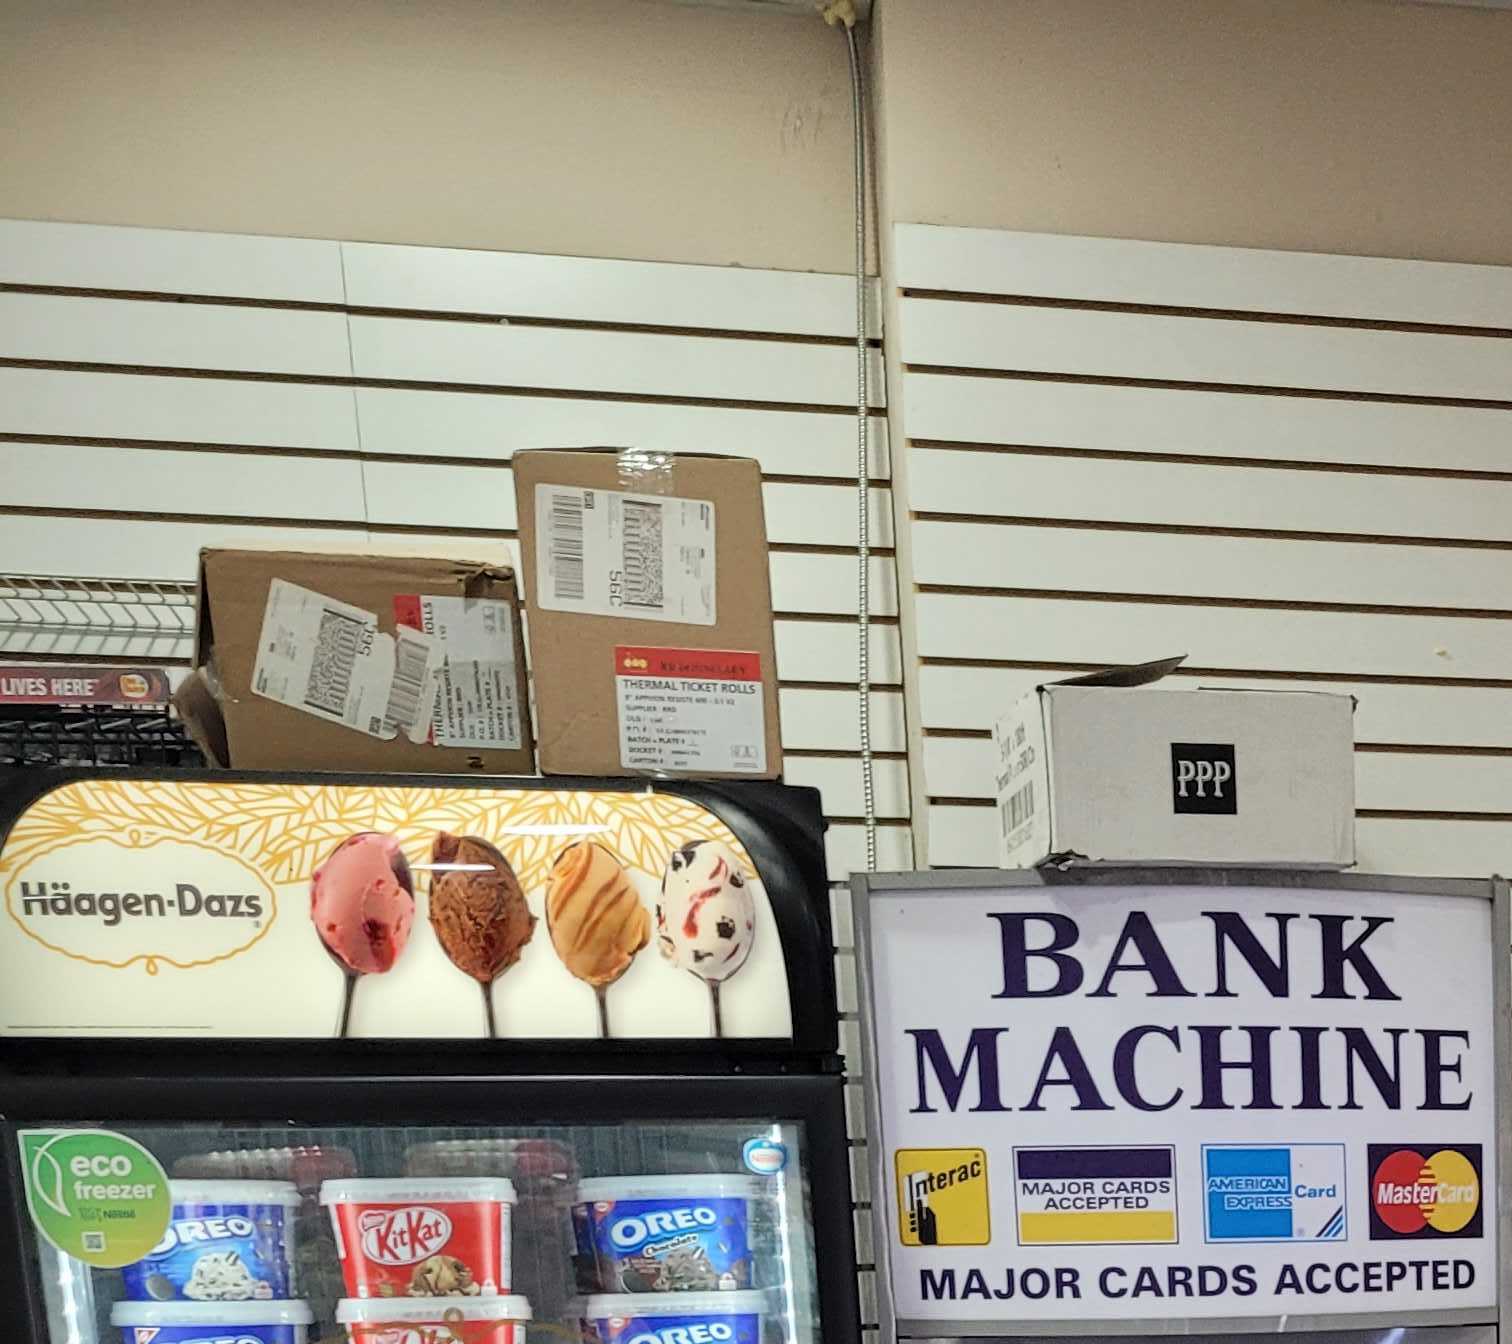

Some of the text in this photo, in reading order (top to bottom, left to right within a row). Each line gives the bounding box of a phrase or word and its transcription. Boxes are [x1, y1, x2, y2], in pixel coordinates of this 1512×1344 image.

[1, 678, 95, 696] LIVES HERE
[623, 679, 756, 695] THERMAL TICKET ROLLS
[1177, 760, 1231, 797] PPP
[20, 881, 263, 926] Häagen-Dazs
[987, 911, 1402, 1001] BANK
[905, 1024, 1474, 1113] MACHINE
[70, 1154, 132, 1176] eco
[73, 1181, 156, 1200] freezer
[1021, 1180, 1171, 1196] MAJOR CARDS
[1208, 1177, 1337, 1199] AMERICAN Card
[1378, 1183, 1475, 1205] MasterCard
[1044, 1195, 1150, 1210] ACCEPTED
[1225, 1196, 1293, 1210] EXPRESS
[376, 1210, 443, 1261] KitKat
[611, 1206, 717, 1247] OREO
[645, 1233, 699, 1256] Chocolate
[920, 1259, 1476, 1301] MAJOR CARDS ACCEPTED
